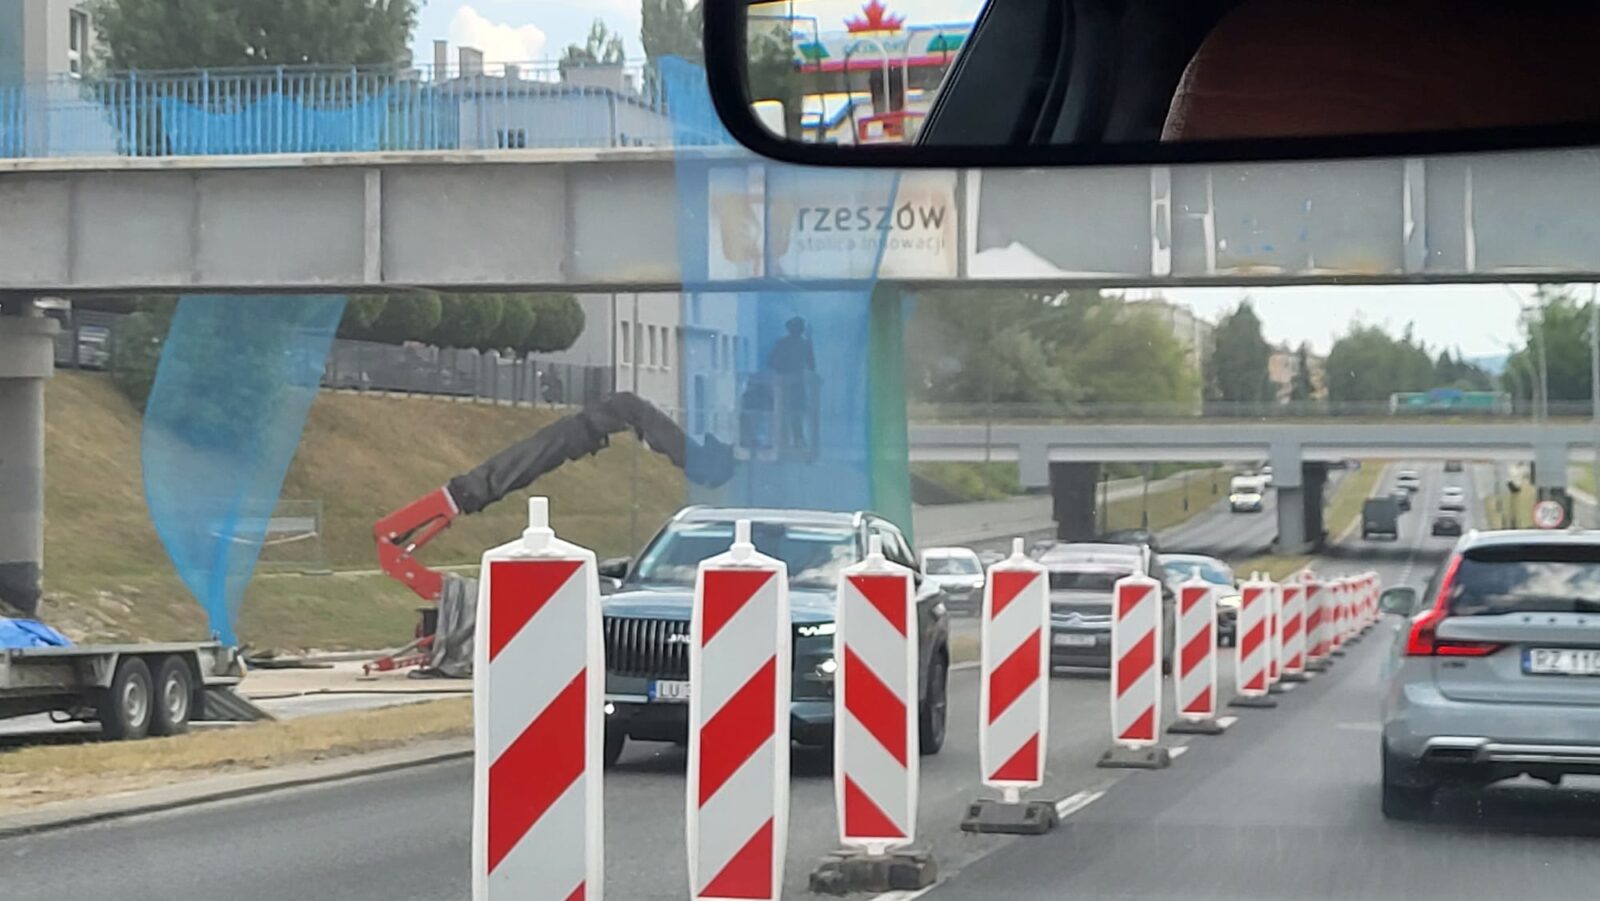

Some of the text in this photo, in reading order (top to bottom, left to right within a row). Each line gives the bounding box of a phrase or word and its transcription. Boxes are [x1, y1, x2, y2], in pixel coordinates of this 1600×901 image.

[797, 201, 946, 232] rzeszów
[1536, 650, 1562, 668] RZ
[660, 682, 680, 698] LU
